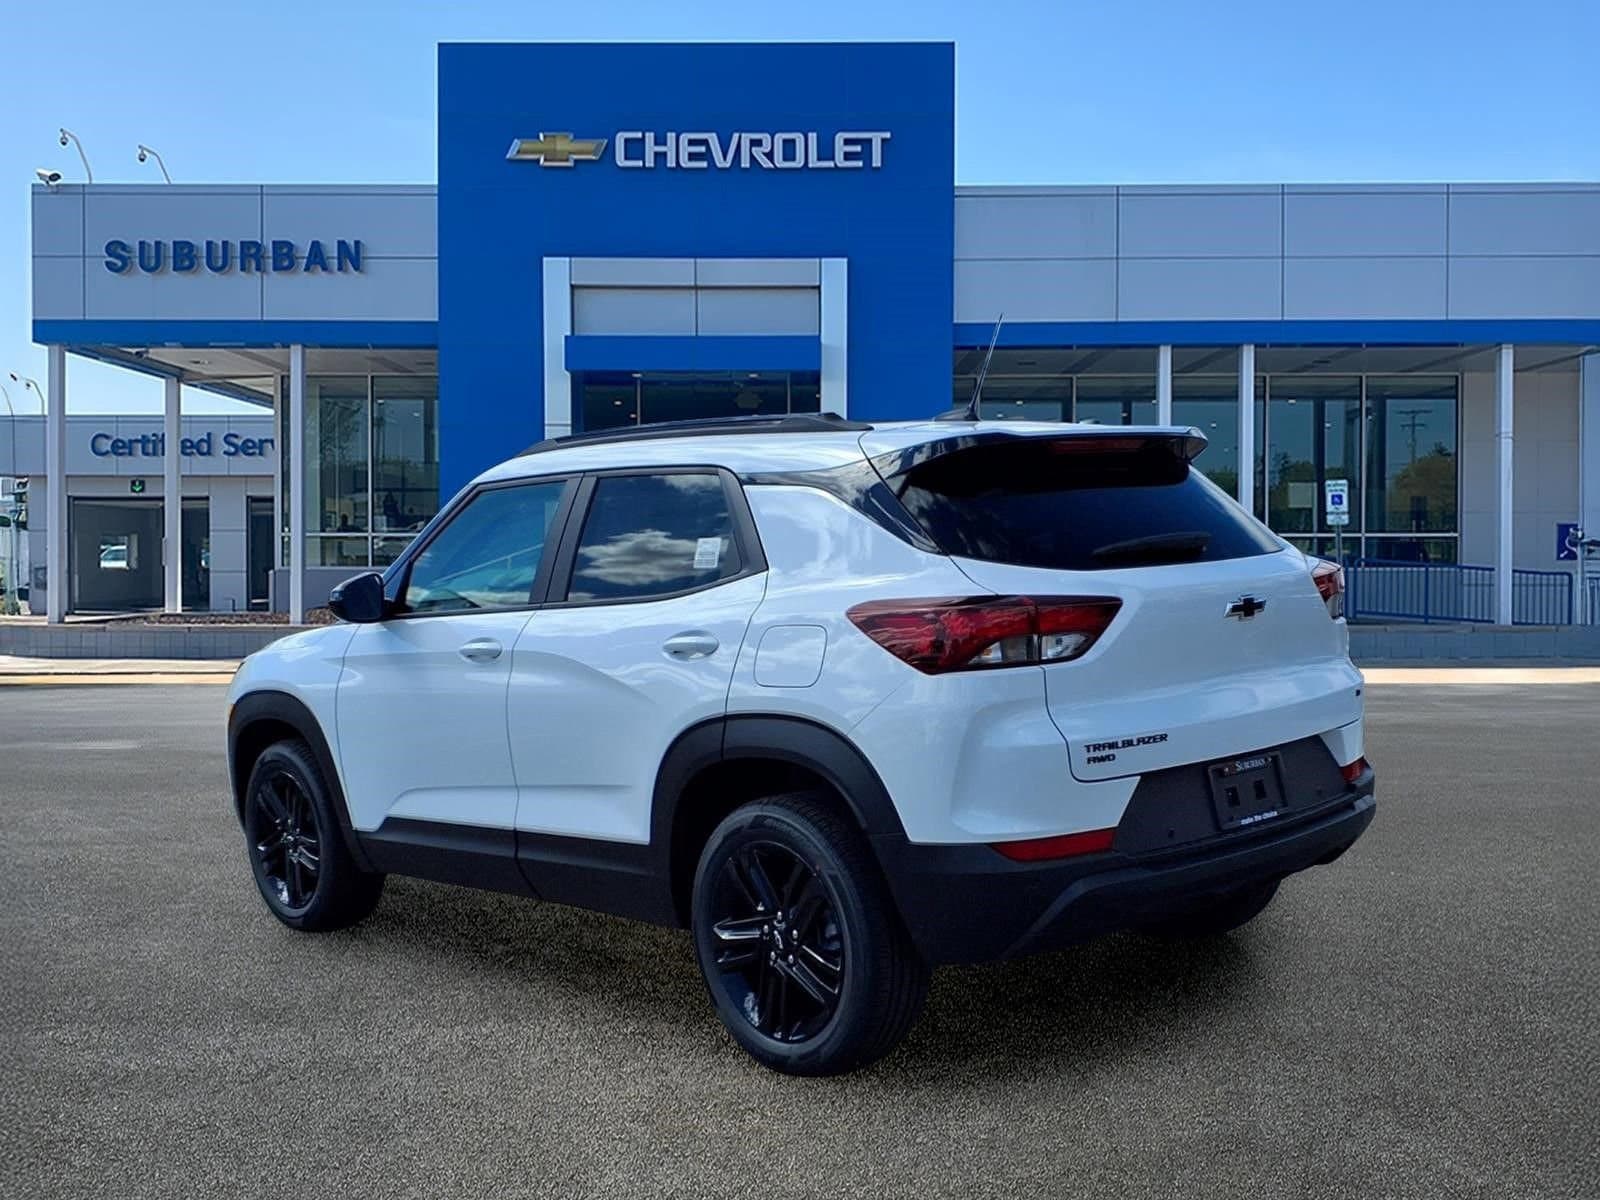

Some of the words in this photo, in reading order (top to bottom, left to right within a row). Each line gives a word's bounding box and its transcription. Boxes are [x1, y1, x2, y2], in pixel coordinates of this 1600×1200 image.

[615, 131, 892, 170] CHEVROLET
[104, 239, 362, 273] SUBURBAN
[90, 432, 213, 457] Certifed
[1084, 733, 1168, 753] TRAILBLAZER
[1086, 753, 1116, 764] AWD
